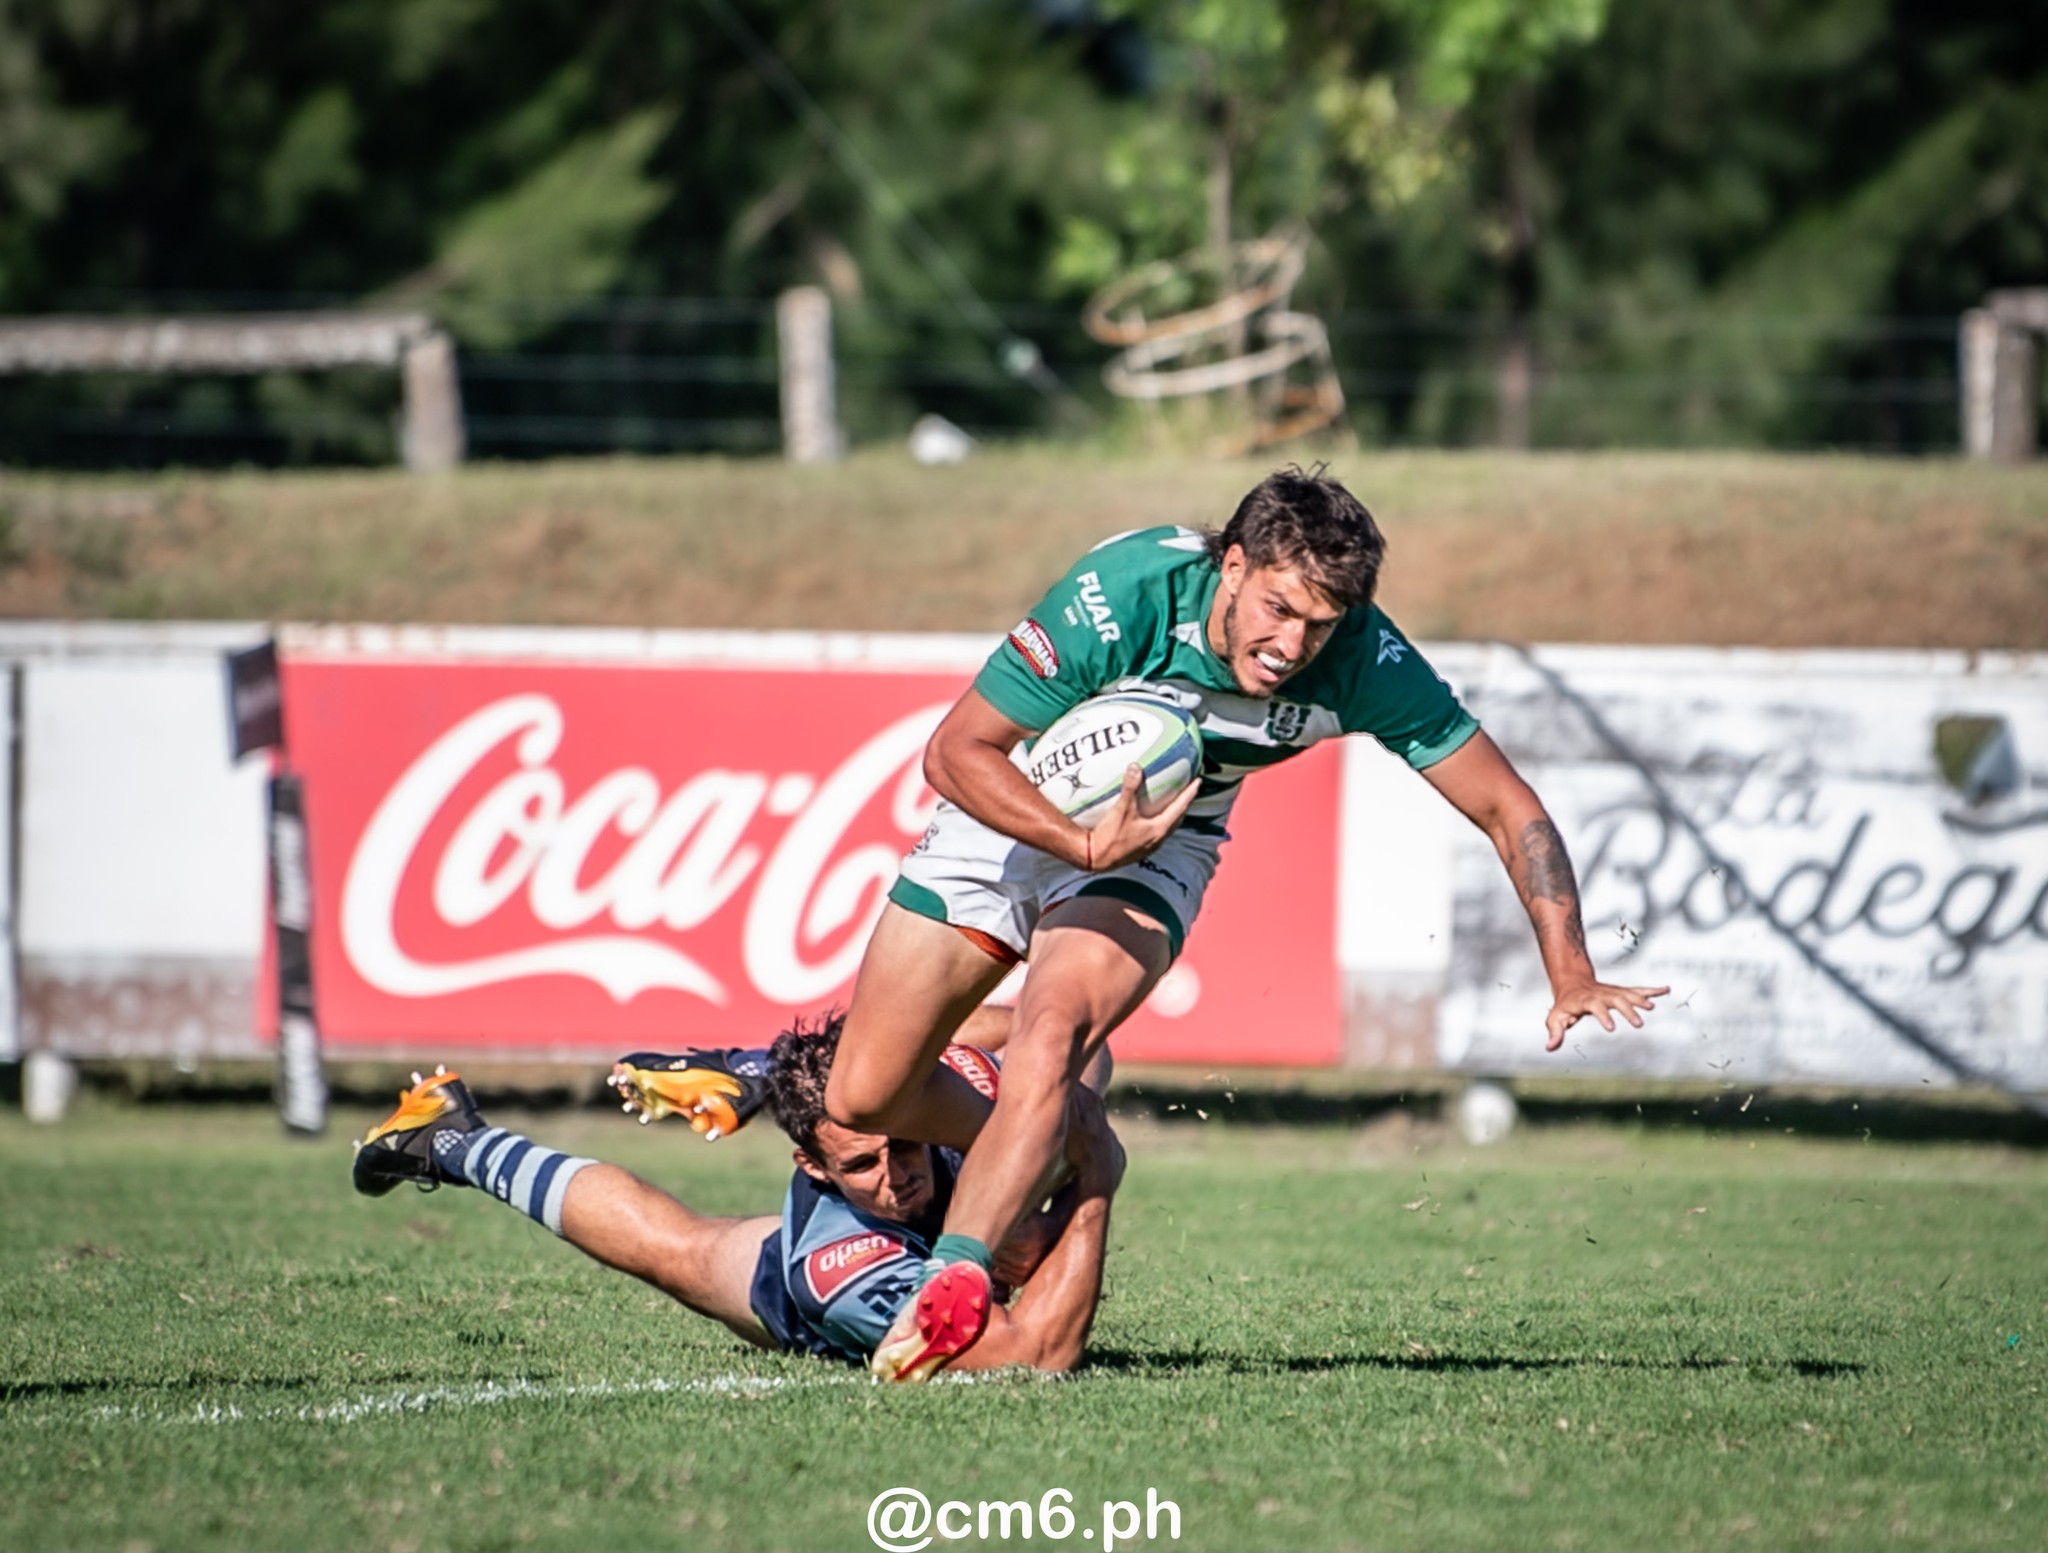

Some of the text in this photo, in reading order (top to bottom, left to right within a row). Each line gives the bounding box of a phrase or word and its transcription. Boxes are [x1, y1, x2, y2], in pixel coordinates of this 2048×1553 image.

[1076, 570, 1121, 644] FUAR
[1031, 720, 1141, 788] GILBER
[341, 693, 960, 1006] Coca-C
[1574, 800, 2048, 984] Bodeg
[946, 1045, 995, 1096] uado
[819, 1235, 889, 1272] open
